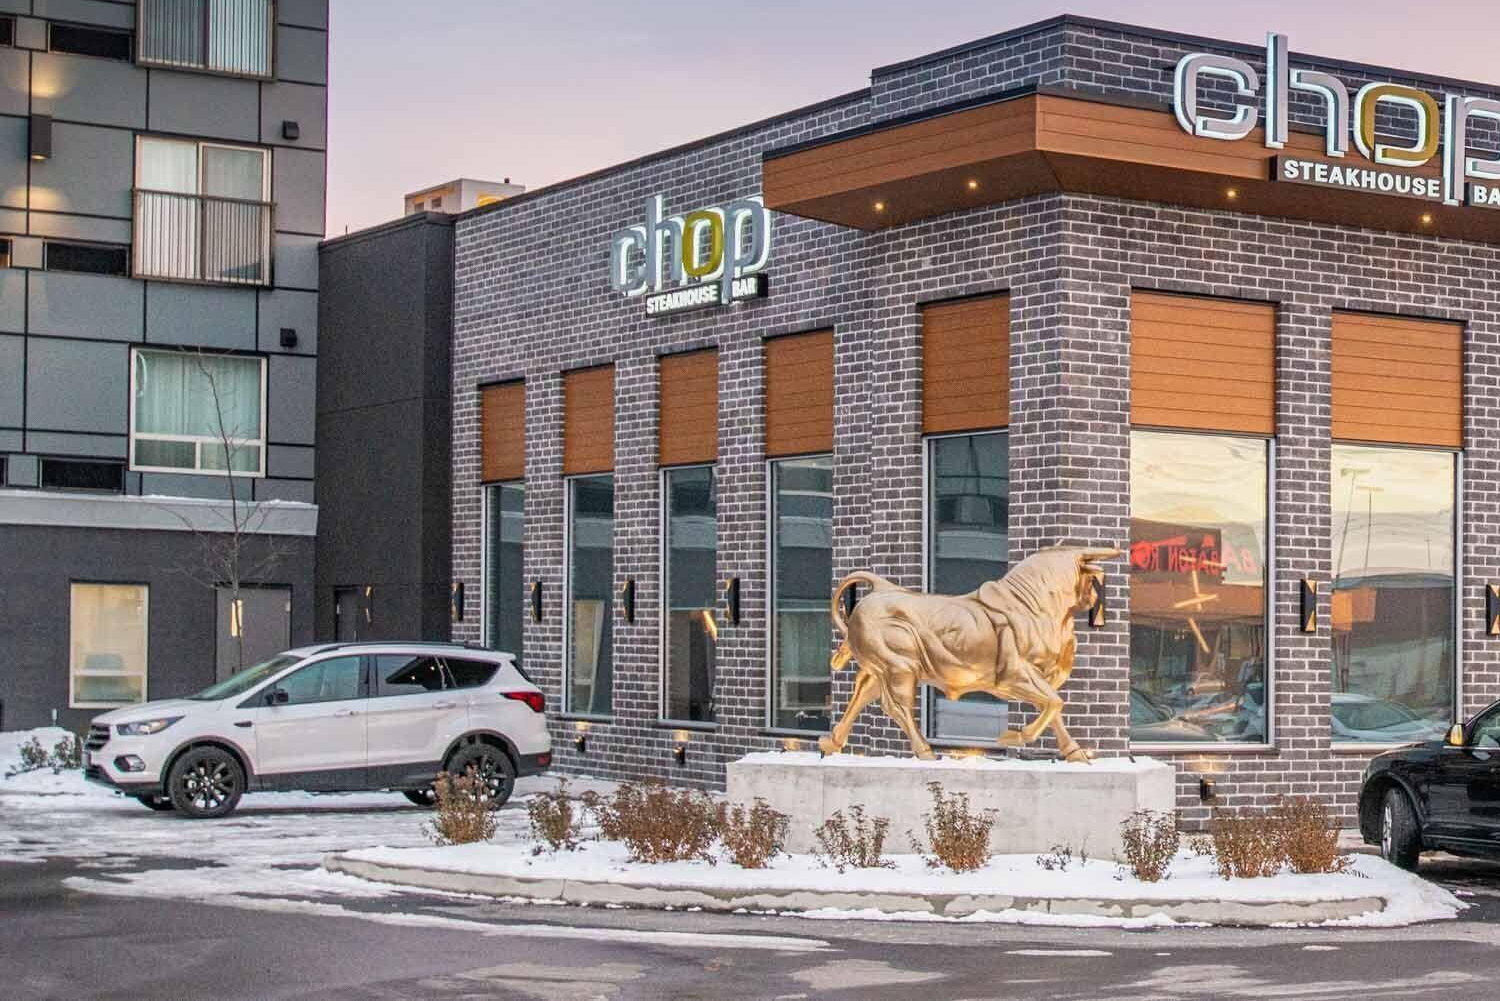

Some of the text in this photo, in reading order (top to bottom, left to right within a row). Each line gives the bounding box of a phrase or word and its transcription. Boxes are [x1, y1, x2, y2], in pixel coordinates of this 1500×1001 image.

[1283, 158, 1441, 198] STEAKHOUSE
[609, 195, 771, 305] chop
[646, 277, 758, 314] STEAKHOUSE BAR
